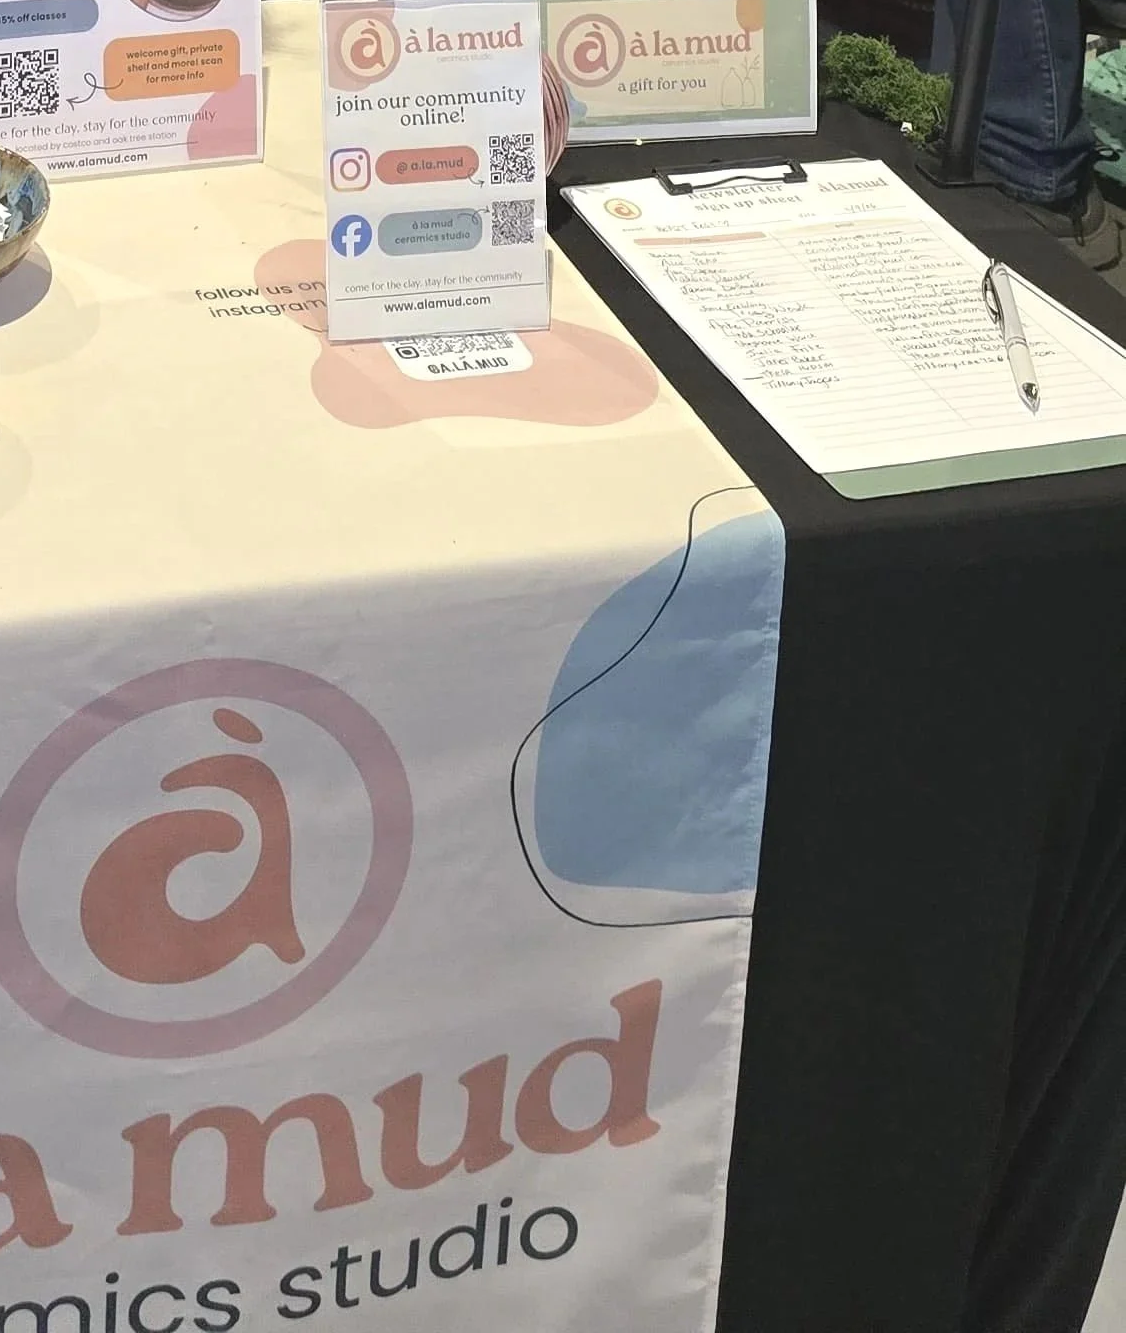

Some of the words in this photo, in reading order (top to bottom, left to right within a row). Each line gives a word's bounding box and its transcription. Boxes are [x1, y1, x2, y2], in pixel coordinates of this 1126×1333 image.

[17, 14, 30, 23] off
[31, 13, 67, 22] classes
[404, 28, 423, 54] à
[427, 27, 453, 53] la
[457, 22, 524, 51] mud
[629, 32, 648, 58] à
[653, 30, 680, 57] la
[684, 30, 752, 56] mud
[126, 48, 169, 60] welcome
[170, 45, 189, 58] gift,
[190, 43, 223, 56] private
[127, 61, 150, 73] shelf
[151, 61, 170, 71] and
[171, 58, 199, 69] more!
[200, 56, 223, 66] scan
[146, 74, 160, 84] for
[161, 73, 185, 82] more
[186, 71, 205, 81] info
[617, 82, 627, 92] a
[629, 78, 654, 95] gift
[657, 77, 679, 90] for
[680, 78, 707, 93] you
[335, 95, 372, 117] join
[377, 95, 410, 110] our
[415, 86, 526, 107] community
[11, 126, 29, 139] for
[32, 124, 51, 137] the
[82, 119, 107, 133] stay
[109, 116, 127, 130] for
[129, 114, 149, 128] the
[152, 109, 217, 127] community
[400, 106, 466, 127] online!
[49, 142, 61, 152] by
[62, 138, 92, 149] costco
[93, 136, 110, 146] and
[148, 131, 177, 141] station
[47, 152, 148, 171] www.alamud.com
[411, 157, 464, 172] a.la.mud
[688, 184, 783, 200] newsletter
[694, 203, 731, 212] sign
[734, 199, 754, 209] up
[758, 195, 803, 206] sheet
[420, 220, 431, 230] la
[432, 219, 454, 229] mud
[394, 232, 439, 245] ceramics
[440, 231, 471, 242] studio
[195, 285, 260, 302] follow
[265, 284, 293, 296] us
[298, 281, 326, 291] on
[345, 284, 369, 293] come
[371, 281, 385, 292] for
[386, 280, 402, 290] the
[443, 275, 457, 287] for
[458, 274, 473, 285] the
[474, 271, 523, 285] community
[208, 299, 327, 319] instagram
[384, 295, 491, 313] www.alamud.com
[116, 978, 663, 1236] mud
[276, 1196, 579, 1320] studio
